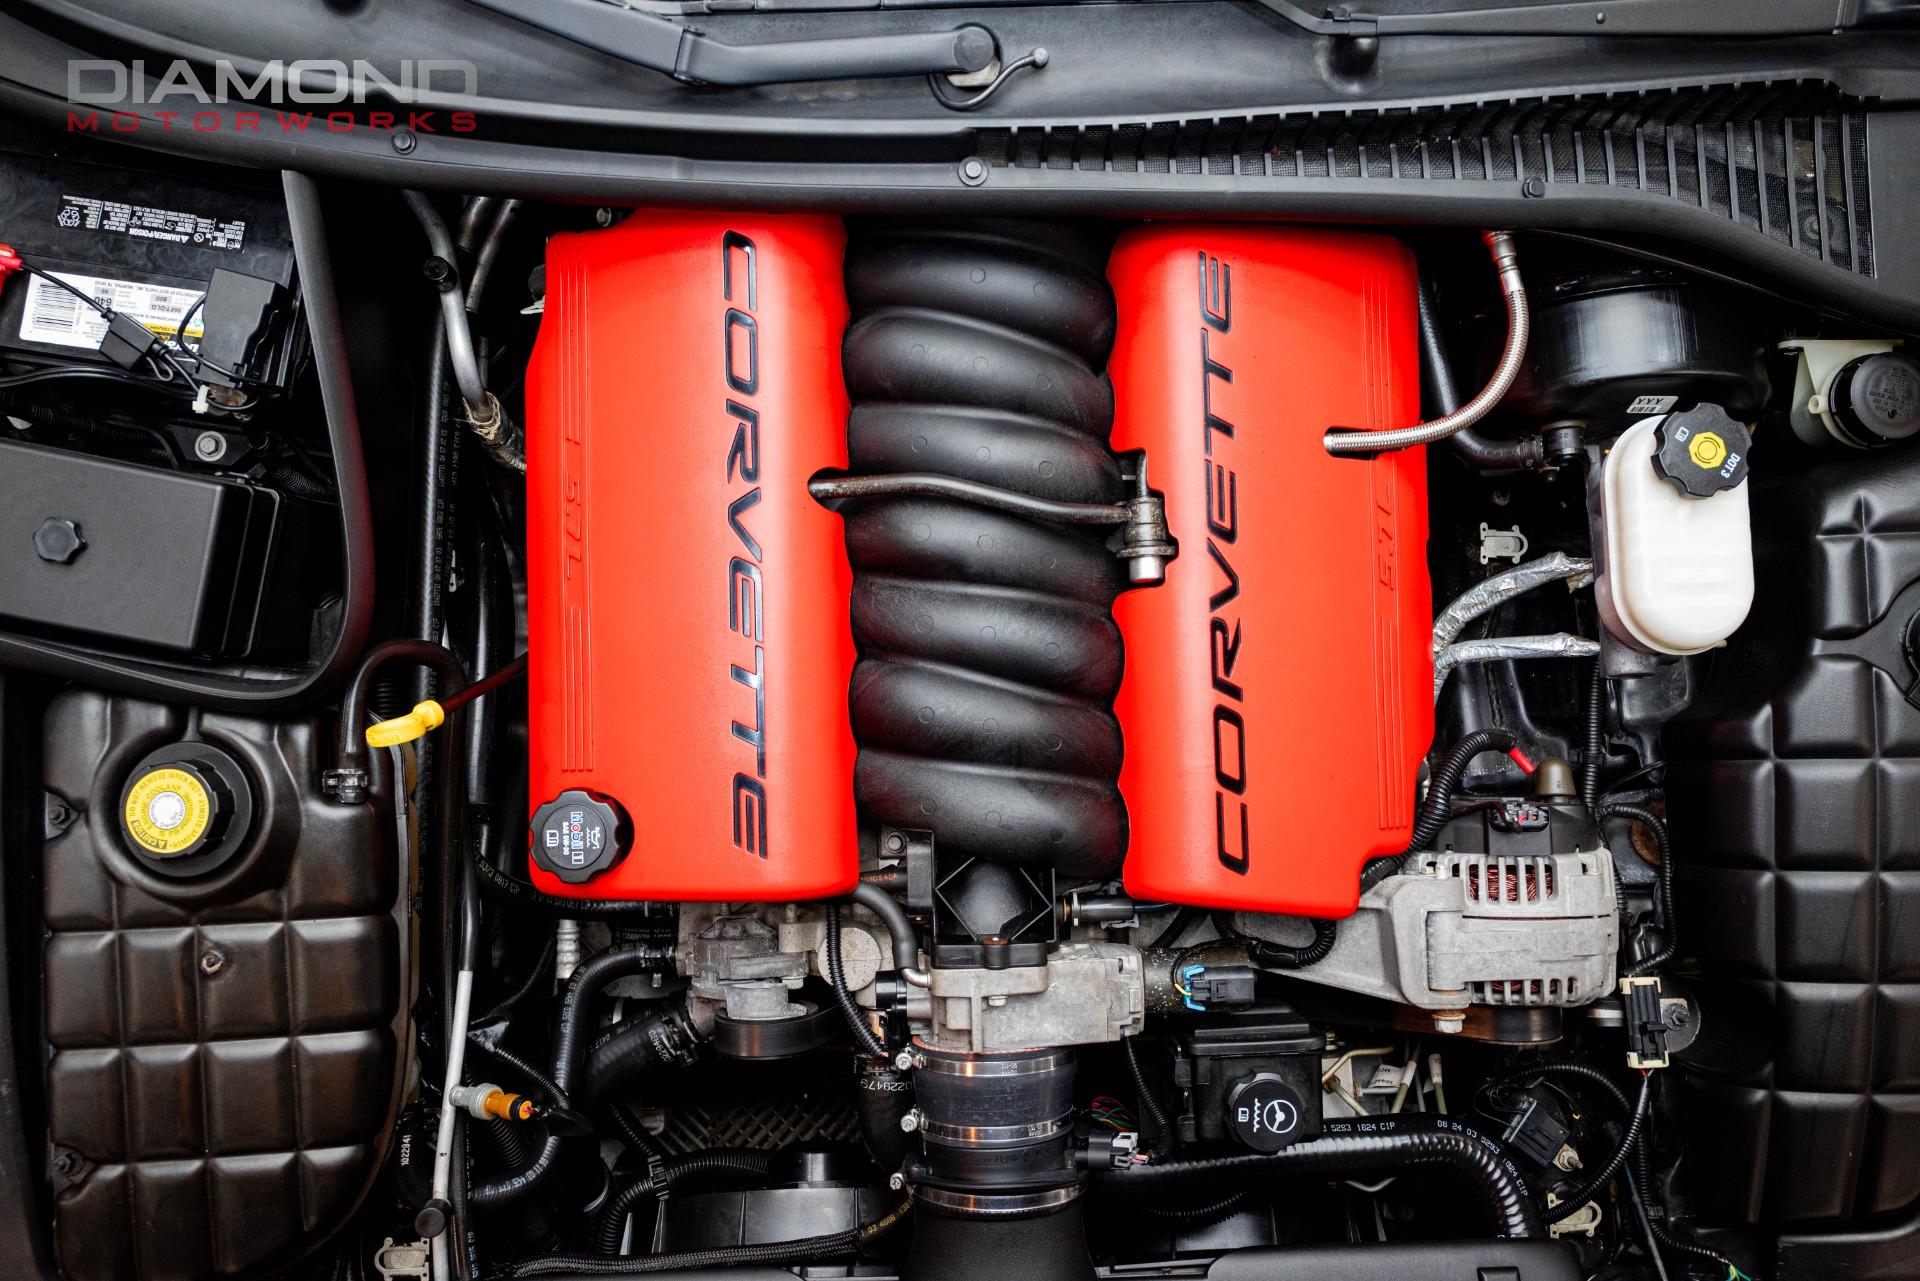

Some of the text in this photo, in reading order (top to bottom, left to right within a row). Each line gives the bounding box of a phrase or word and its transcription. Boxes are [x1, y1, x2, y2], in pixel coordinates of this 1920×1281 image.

[1637, 397, 1665, 405] YYY
[1720, 452, 1742, 478] DOT 3
[722, 229, 769, 861] CORVETTE
[1198, 250, 1250, 876] CORVETTE
[140, 772, 165, 791] REMOVE
[168, 773, 188, 783] WHEN
[132, 820, 158, 847] CAUTION
[562, 822, 570, 834] SAE
[570, 811, 583, 849] Mobil
[1330, 1124, 1352, 1132] 5293
[1357, 1123, 1377, 1131] 1824
[1379, 1121, 1395, 1130] CIP
[1437, 1119, 1448, 1128] 06
[1452, 1122, 1462, 1132] 24
[1466, 1128, 1477, 1138] 03
[1480, 1135, 1501, 1154] 5293
[1516, 1178, 1529, 1197] CIP
